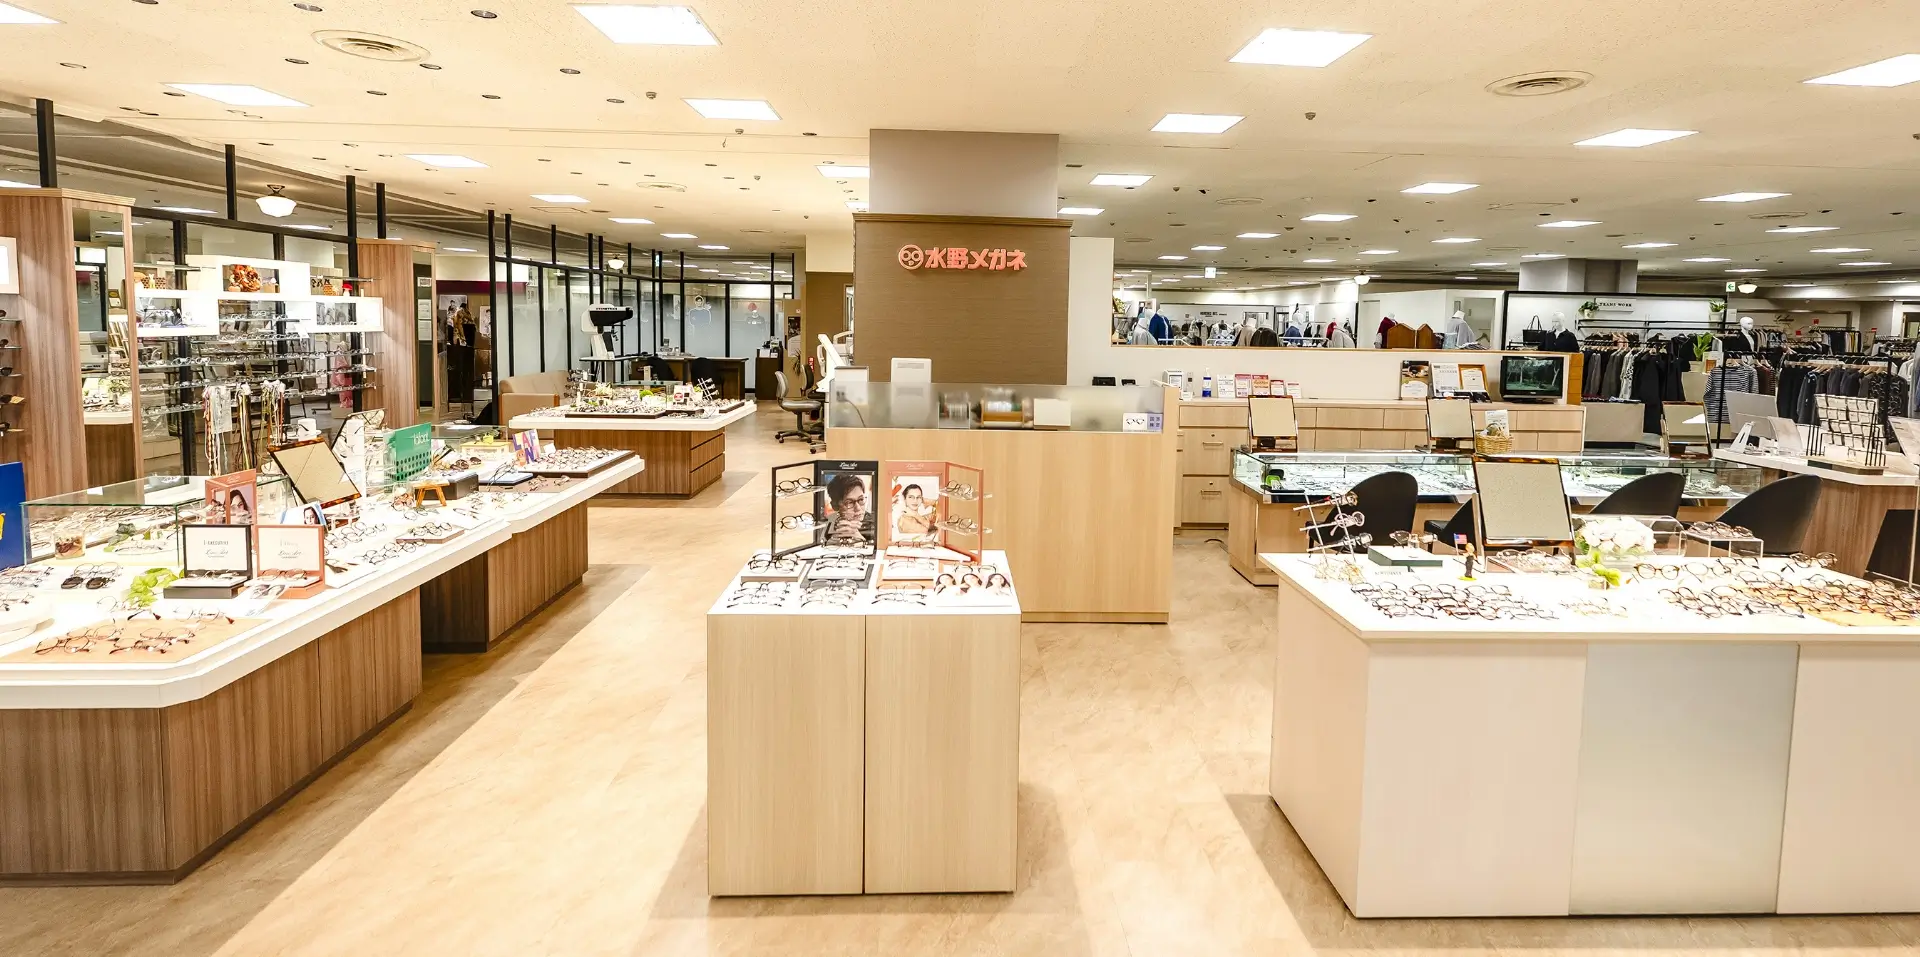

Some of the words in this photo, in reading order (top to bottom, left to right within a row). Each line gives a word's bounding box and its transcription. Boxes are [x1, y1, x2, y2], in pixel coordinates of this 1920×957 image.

[925, 247, 1027, 270] 水野メガネ
